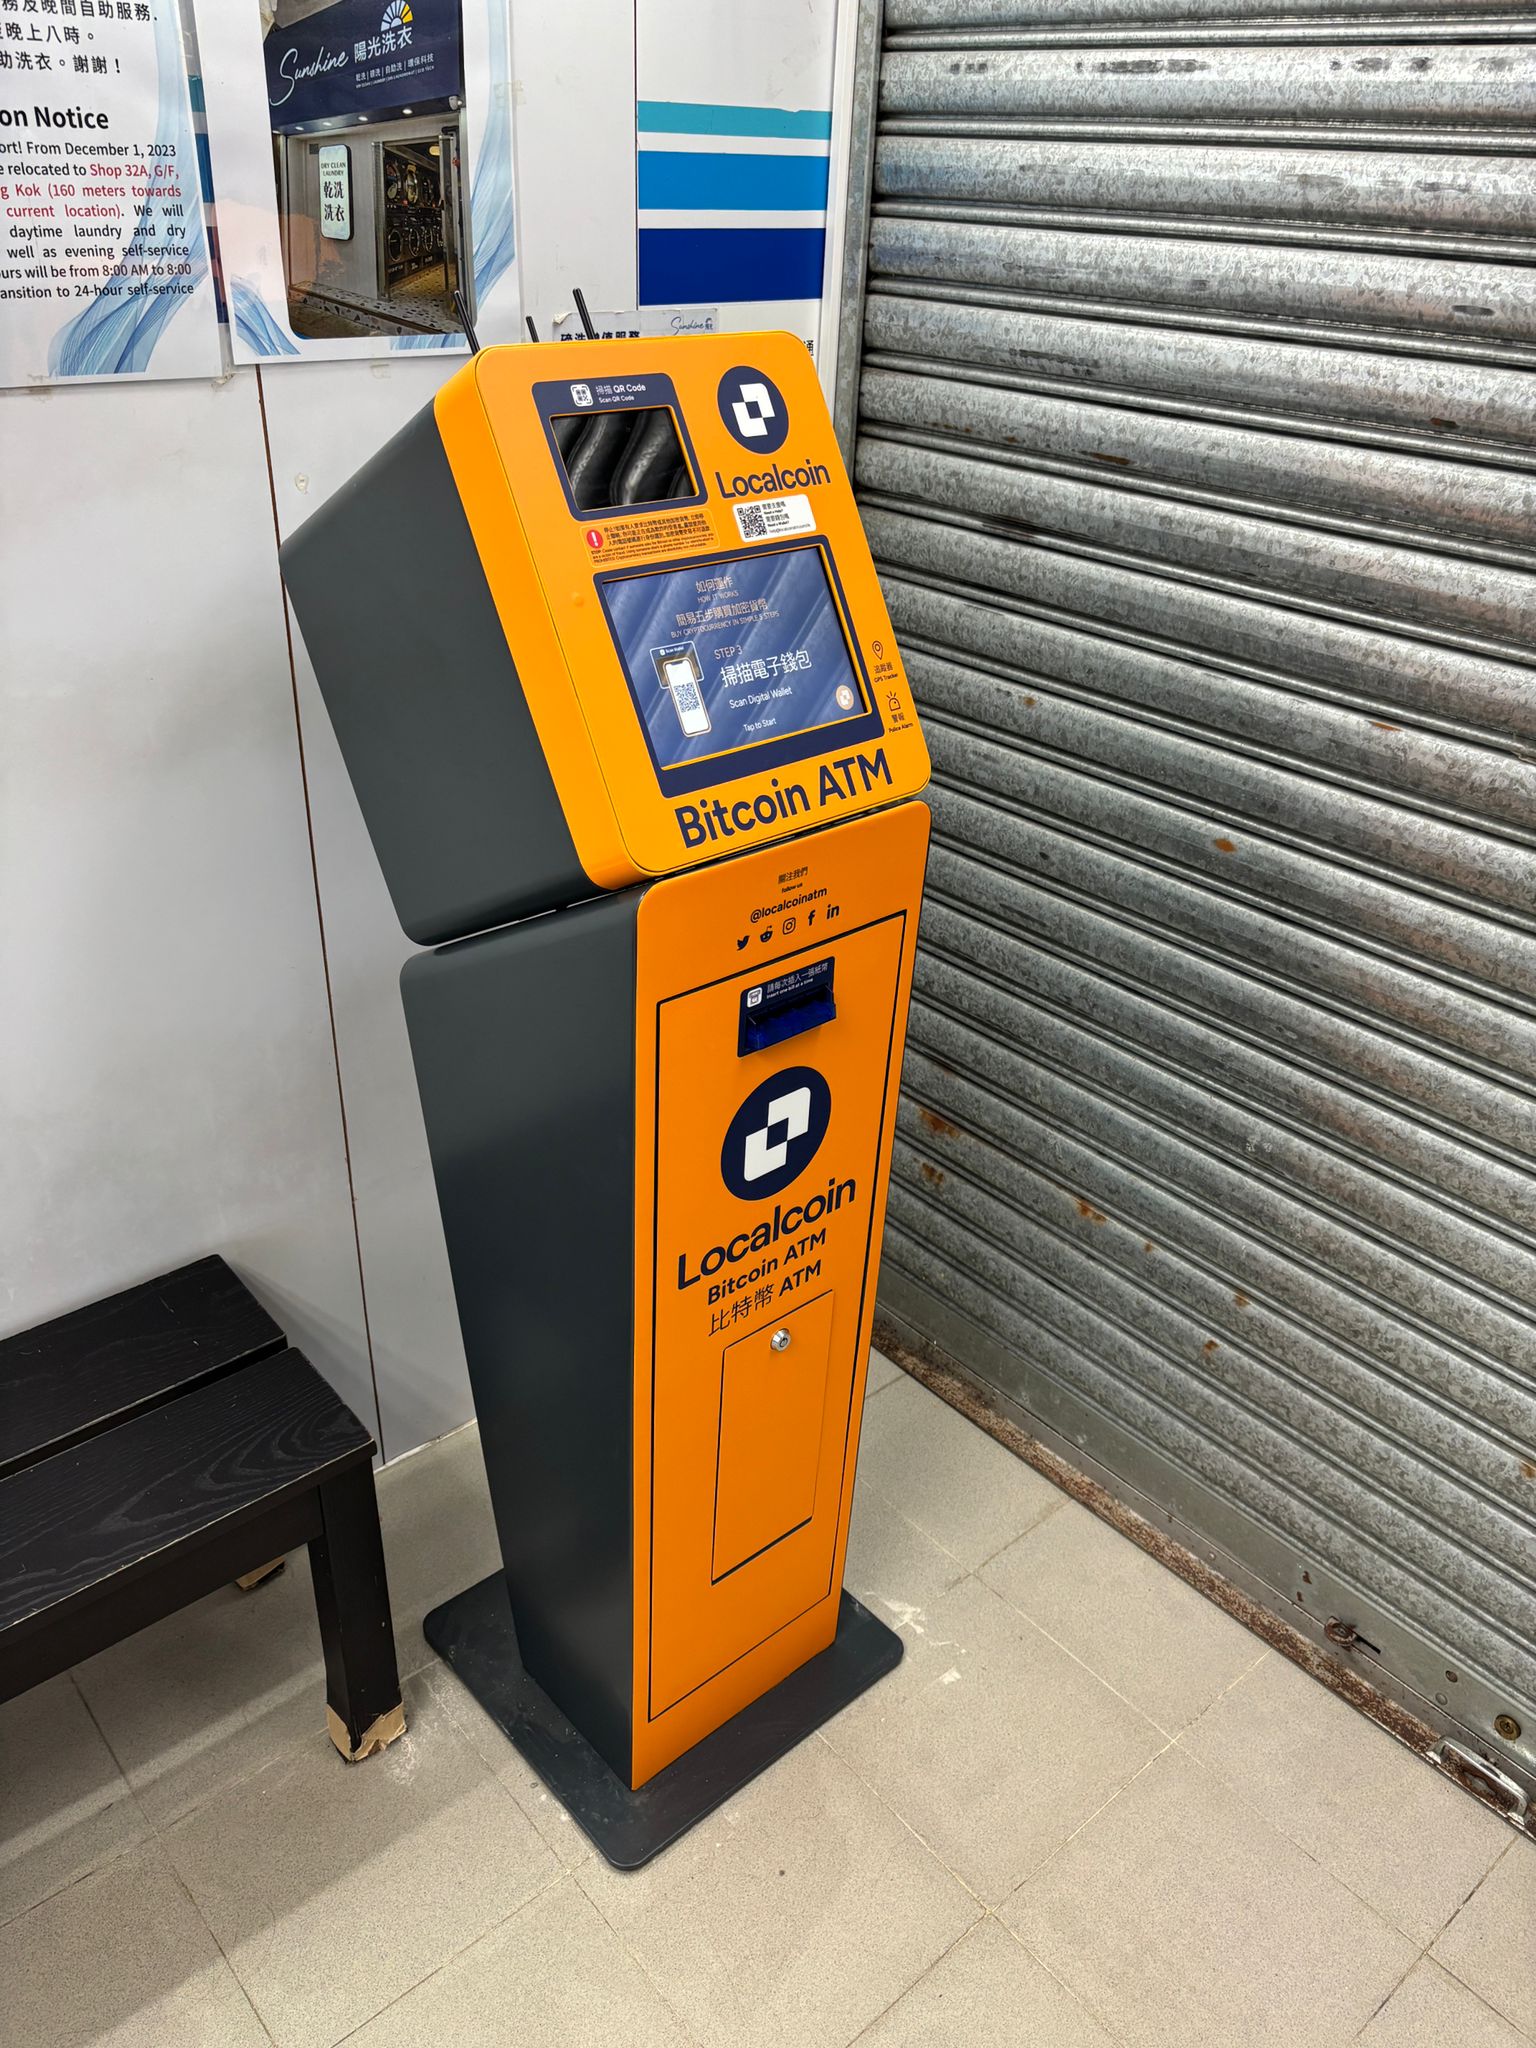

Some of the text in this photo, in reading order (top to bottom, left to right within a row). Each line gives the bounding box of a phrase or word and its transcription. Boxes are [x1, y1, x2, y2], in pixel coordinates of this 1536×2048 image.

[0, 22, 94, 44] 晚上八時。
[354, 25, 413, 63] 陽光洗衣
[269, 46, 349, 106] Sunshine
[33, 105, 109, 130] Notice
[26, 141, 62, 156] From
[64, 142, 129, 157] December
[133, 144, 144, 159] 1,
[147, 144, 177, 157] 2023
[8, 161, 69, 176] relocated
[73, 163, 87, 176] to
[90, 163, 122, 180] Shop
[125, 164, 152, 179] 32A,
[154, 165, 179, 180] G/F,
[320, 161, 347, 170] DRY CLEAN
[322, 169, 345, 177] LAUNDRY
[0, 183, 182, 200] g Kok (160 meters towards
[323, 181, 345, 199] 乾洗
[6, 203, 184, 220] current location). We will
[324, 203, 345, 222] 洗衣
[9, 223, 186, 241] daytime laundry and dry
[7, 243, 190, 261] well as evening self-service
[0, 262, 192, 280] urs will be from 8:00 AM to 8:00
[57, 285, 70, 299] to
[75, 283, 123, 298] 24-hour
[128, 281, 195, 296] self-service
[670, 316, 704, 336] Sunshine
[613, 383, 626, 394] QR
[626, 382, 647, 393] Code
[598, 396, 612, 404] Scan
[621, 394, 635, 402] Code
[714, 458, 832, 499] Localcoin
[695, 575, 734, 594] 如何運作
[697, 595, 711, 603] HOW
[720, 590, 740, 600] WORKS
[671, 629, 684, 639] BUY
[684, 619, 732, 637] CRYPTOCURRENCY
[733, 618, 740, 626] IN
[740, 615, 759, 625] SIMPLE
[763, 610, 780, 620] STEPS
[714, 645, 743, 660] STEP 3
[720, 649, 812, 688] 掃描電子錢包
[729, 686, 793, 709] Scan Digital Wallet
[743, 717, 777, 732] Tap to Start
[674, 747, 894, 849] Bitcoin ATM
[750, 887, 828, 923] @localcoinatm
[677, 1177, 857, 1291] Localcoin
[707, 1227, 827, 1306] Bitcoin ATM
[708, 1259, 822, 1337] 比特幣 ATM
